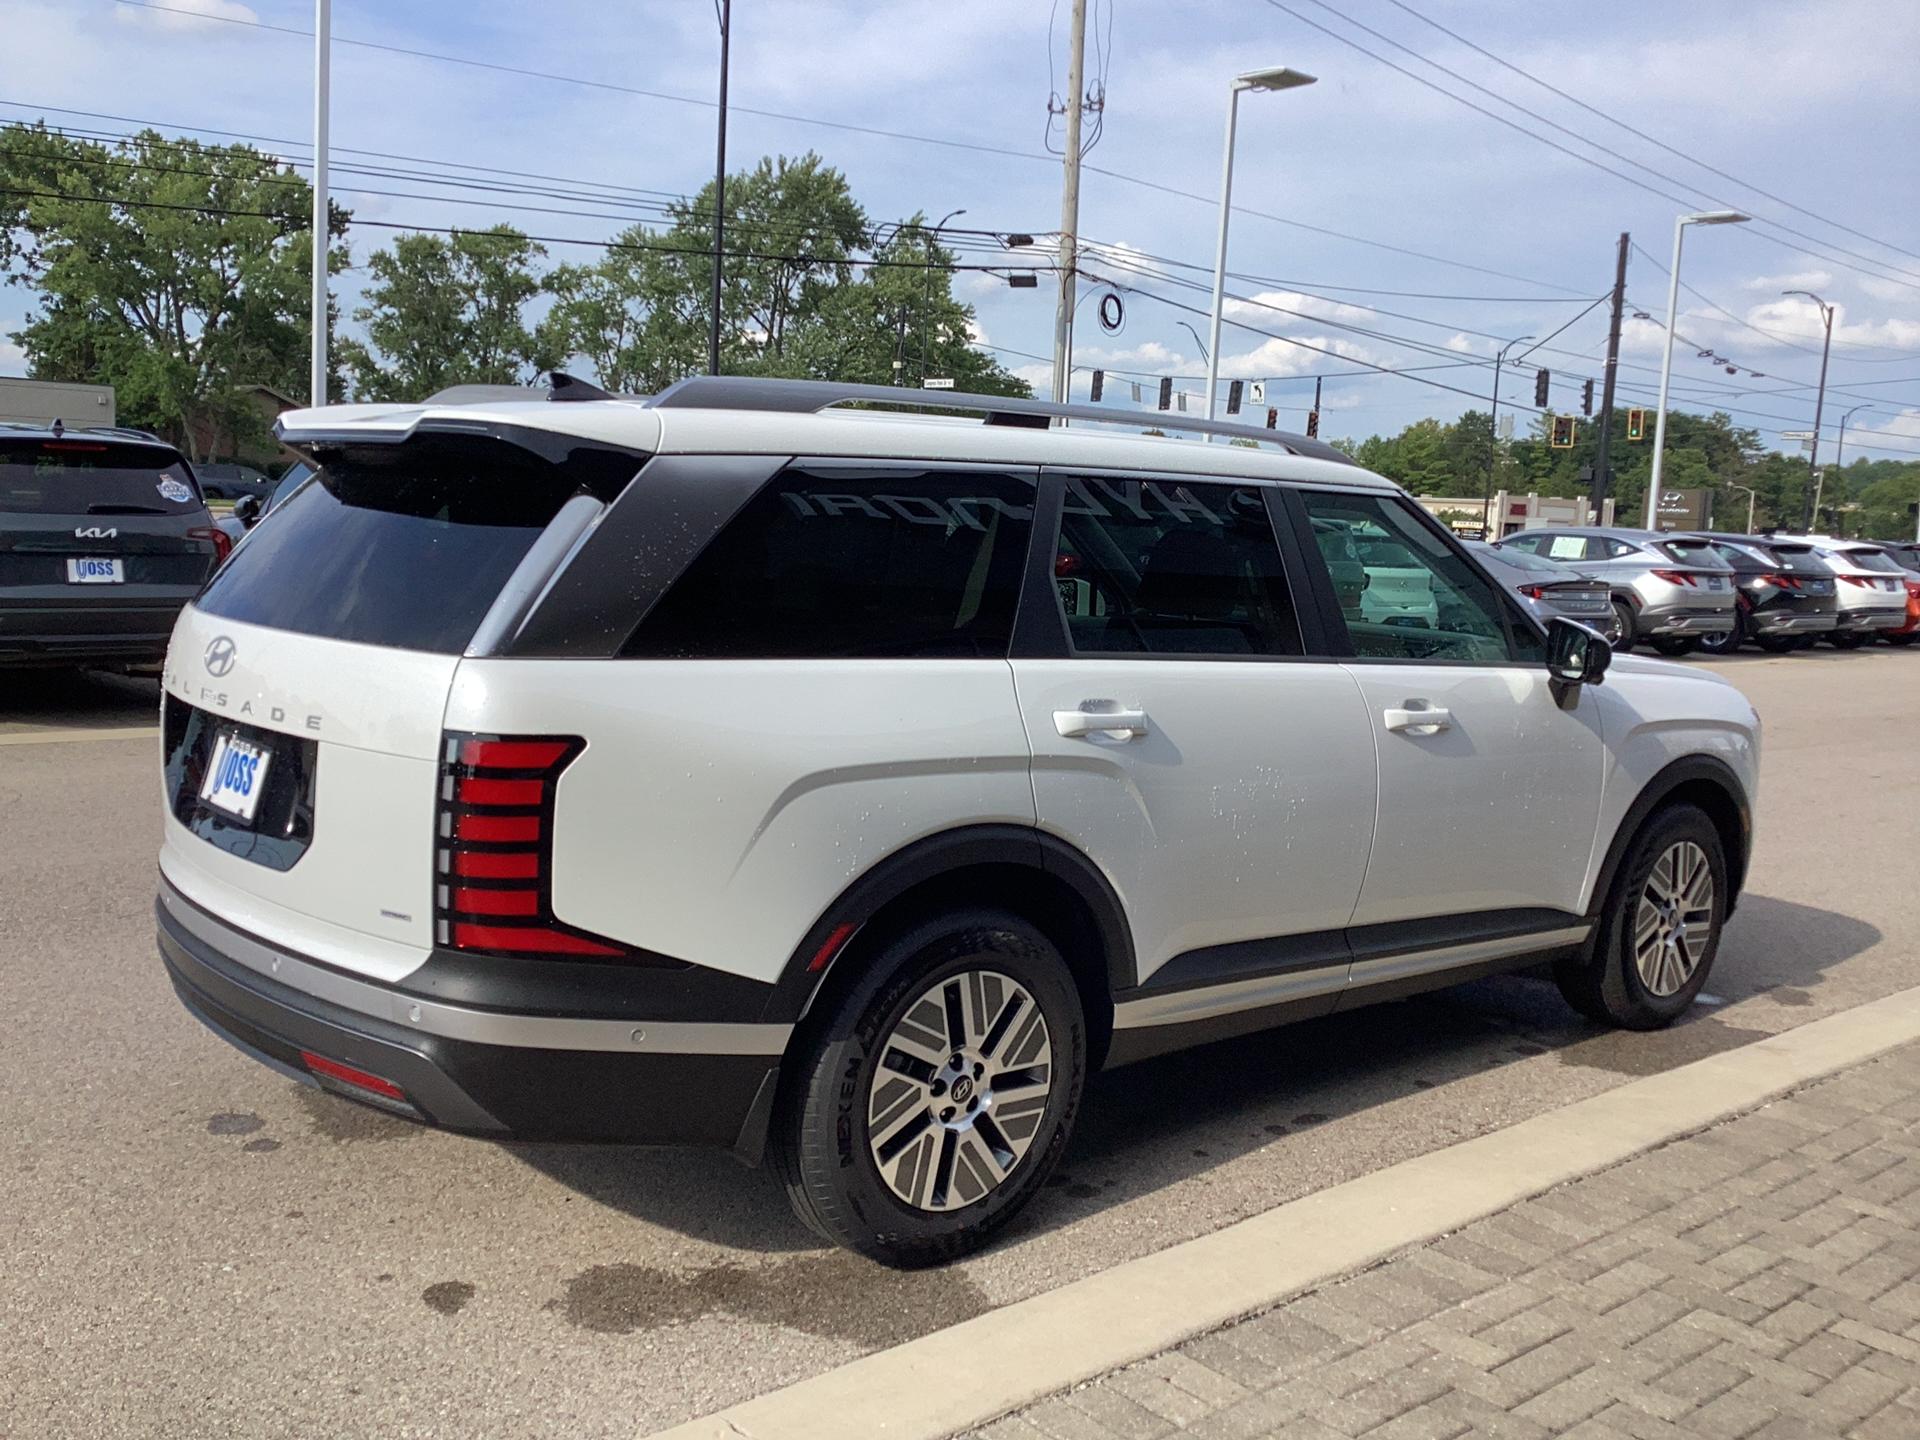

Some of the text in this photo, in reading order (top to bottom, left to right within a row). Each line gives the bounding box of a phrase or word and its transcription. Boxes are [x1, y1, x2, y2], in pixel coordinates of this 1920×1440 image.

[75, 527, 117, 538] KIA
[76, 560, 114, 579] VOSS
[165, 668, 322, 731] ALISADE
[213, 747, 259, 797] VOSS
[837, 1058, 862, 1168] NEXEN
